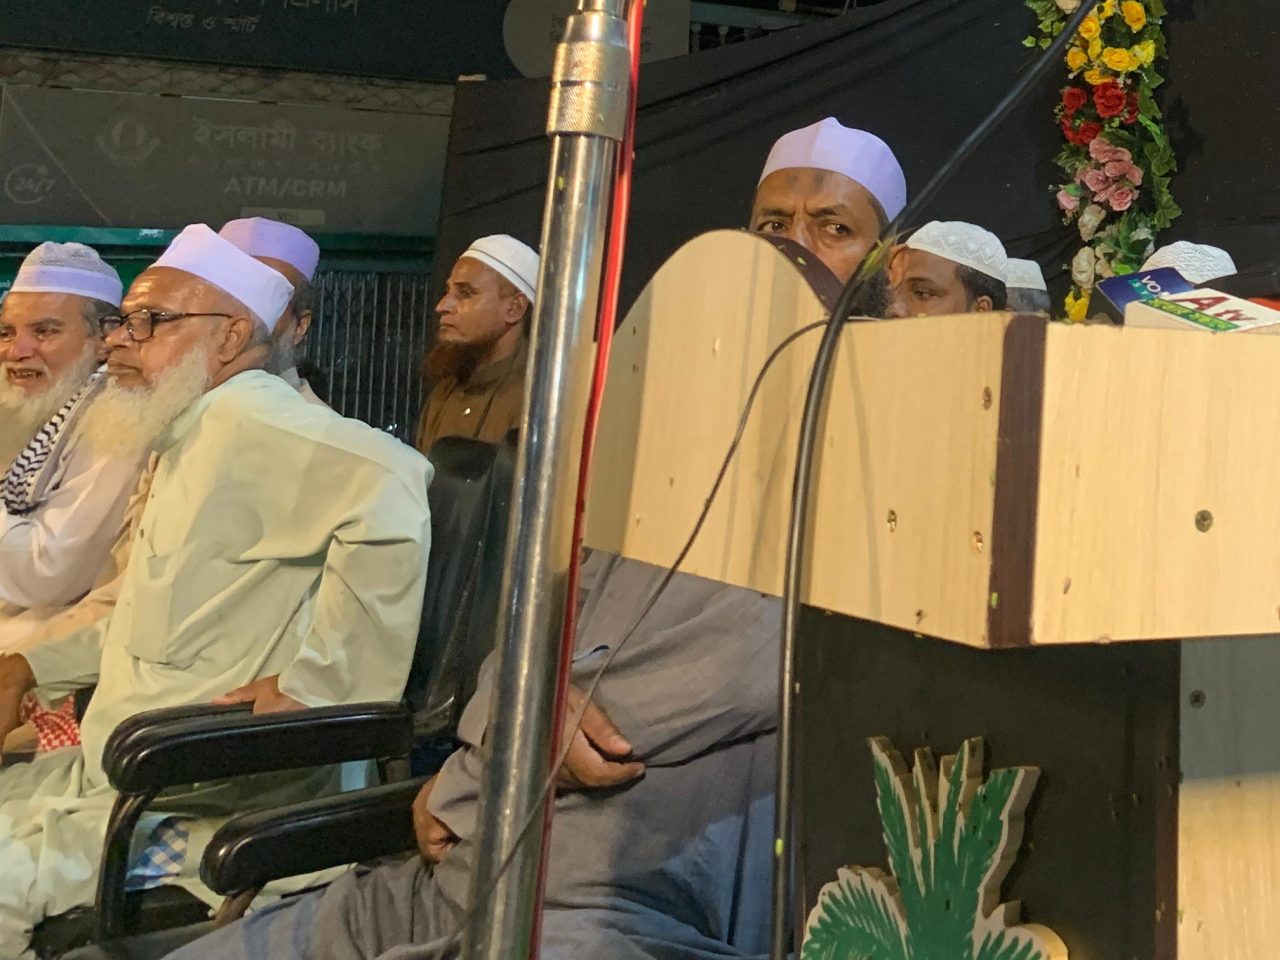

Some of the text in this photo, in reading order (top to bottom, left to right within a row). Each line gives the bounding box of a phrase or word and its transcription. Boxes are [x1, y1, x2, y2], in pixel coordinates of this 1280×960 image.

[202, 16, 216, 30] ও
[193, 116, 384, 154] ইসলামী ব্যাংক
[224, 176, 347, 198] ATM/CRM
